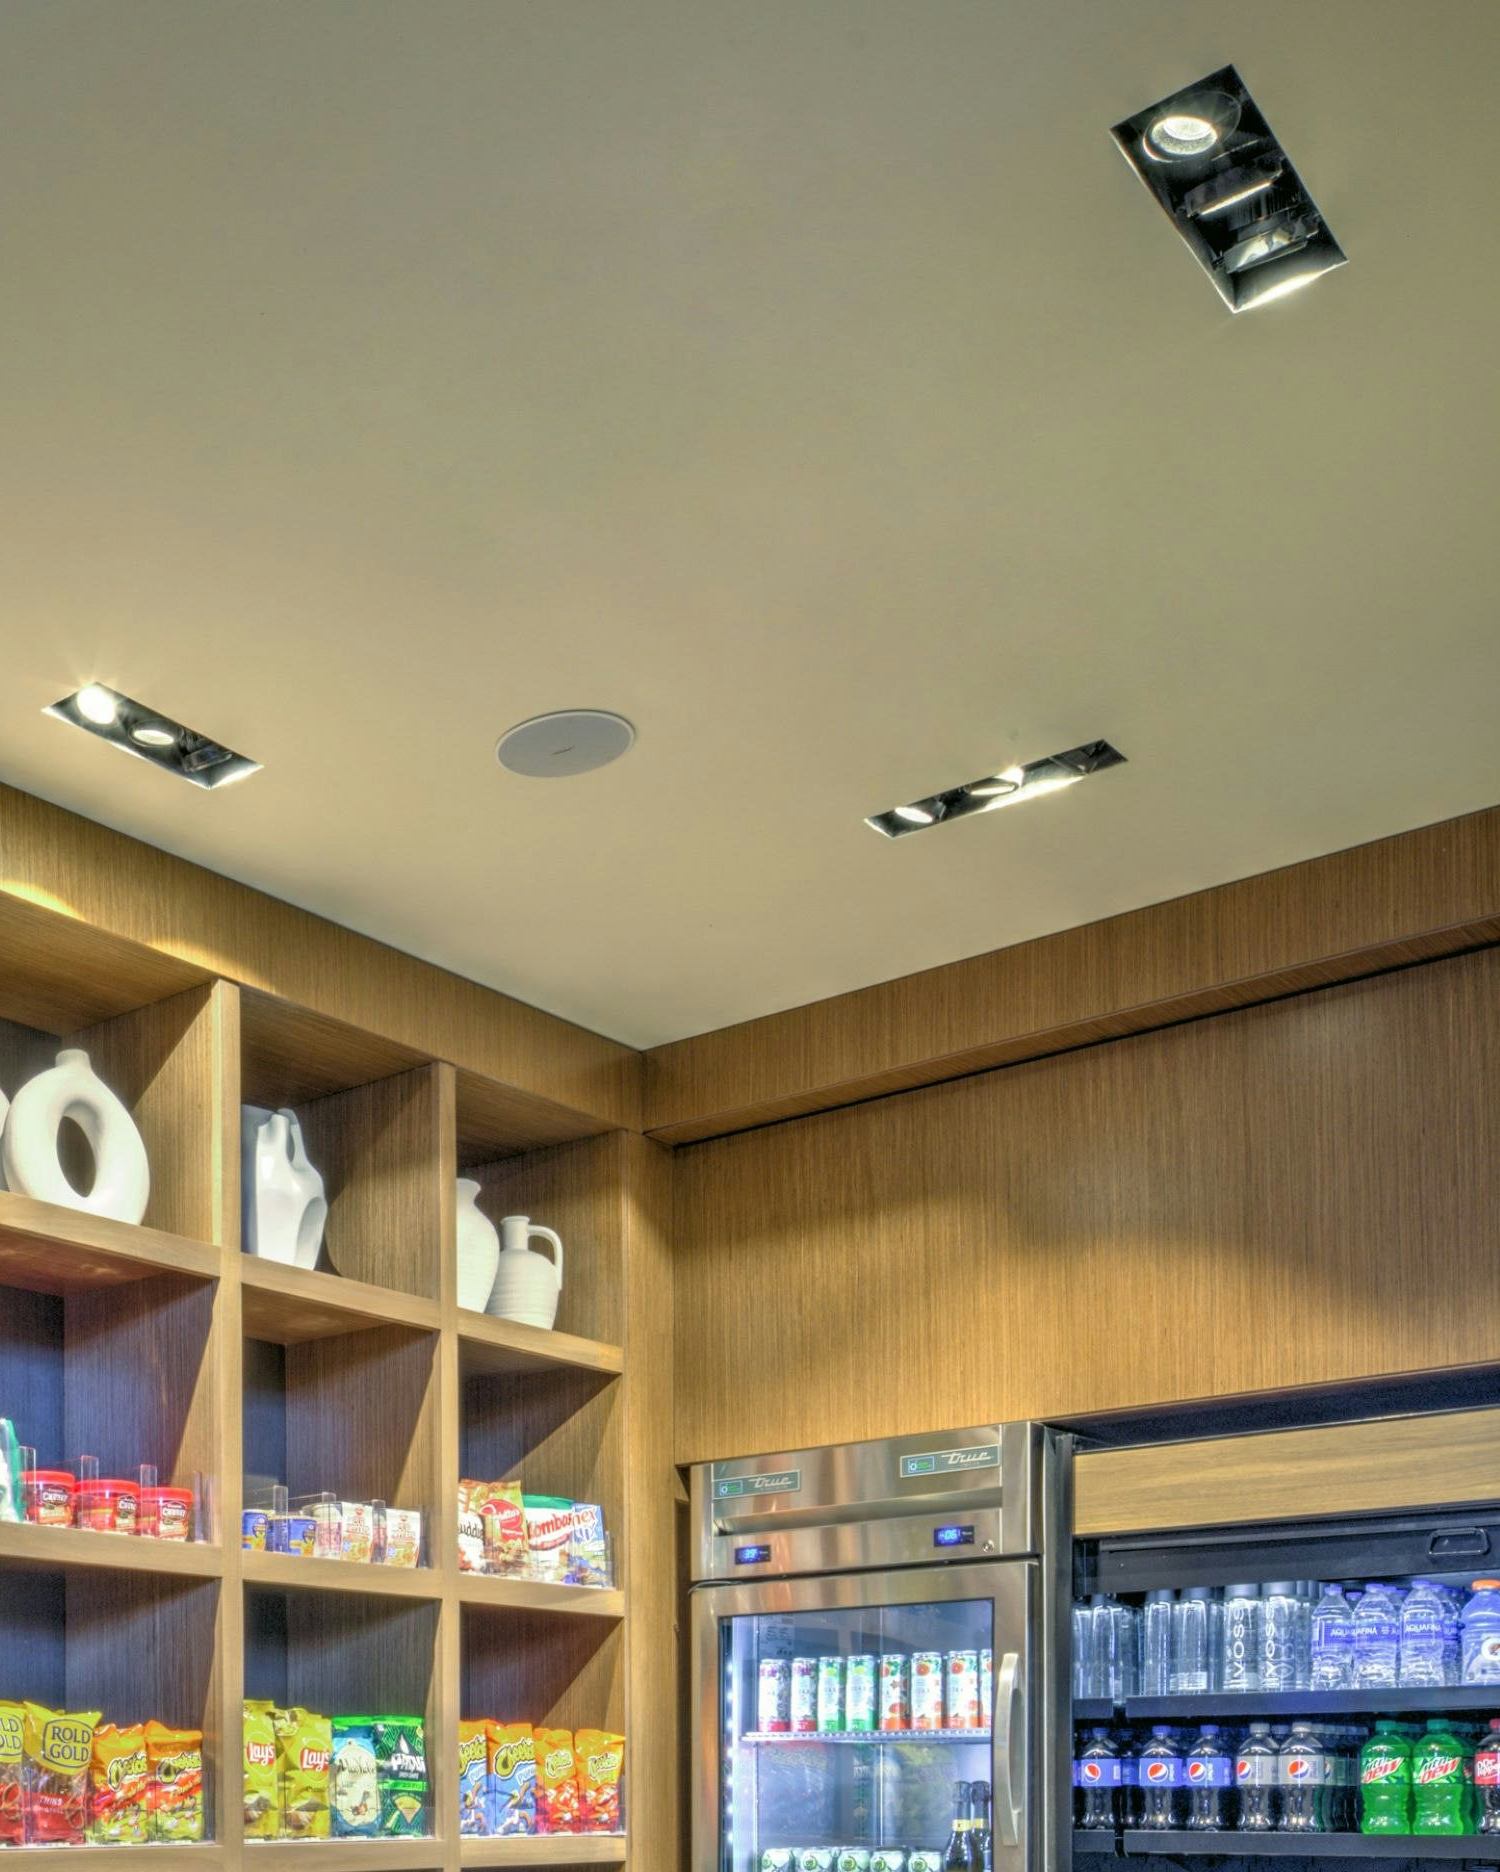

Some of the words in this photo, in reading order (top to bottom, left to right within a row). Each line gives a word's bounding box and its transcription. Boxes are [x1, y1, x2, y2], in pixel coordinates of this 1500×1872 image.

[1232, 1606, 1246, 1678] VOSS
[52, 1725, 90, 1744] ROLD
[49, 1743, 89, 1761] GOLD
[249, 1742, 275, 1765] Lay's
[302, 1748, 330, 1772] Lay's
